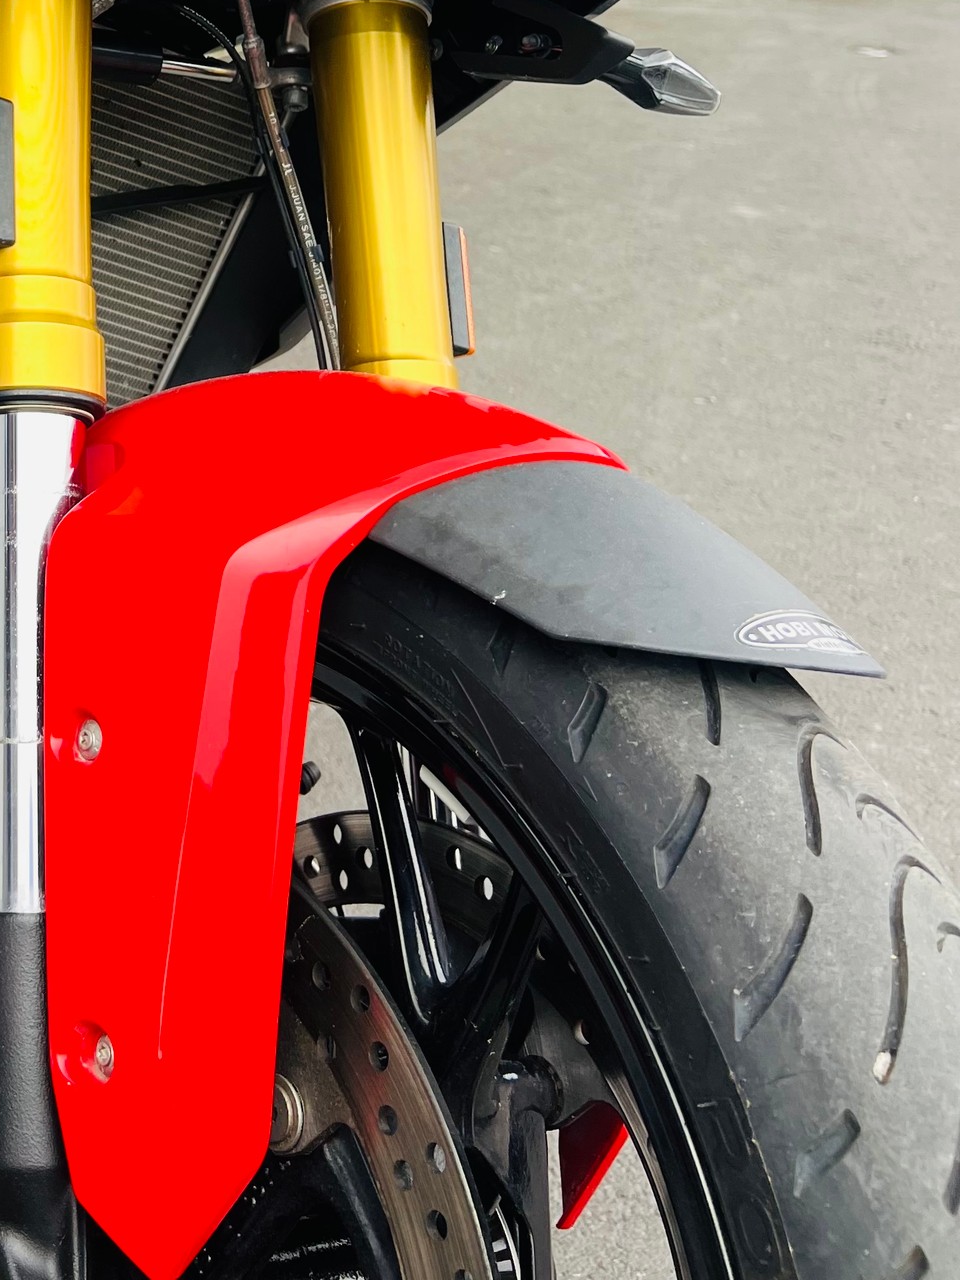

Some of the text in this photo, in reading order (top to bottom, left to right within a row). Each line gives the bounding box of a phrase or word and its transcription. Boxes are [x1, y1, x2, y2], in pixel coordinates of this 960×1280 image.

[289, 184, 306, 222] J.JUAN
[301, 224, 314, 248] SAE
[757, 620, 818, 642] HOBI
